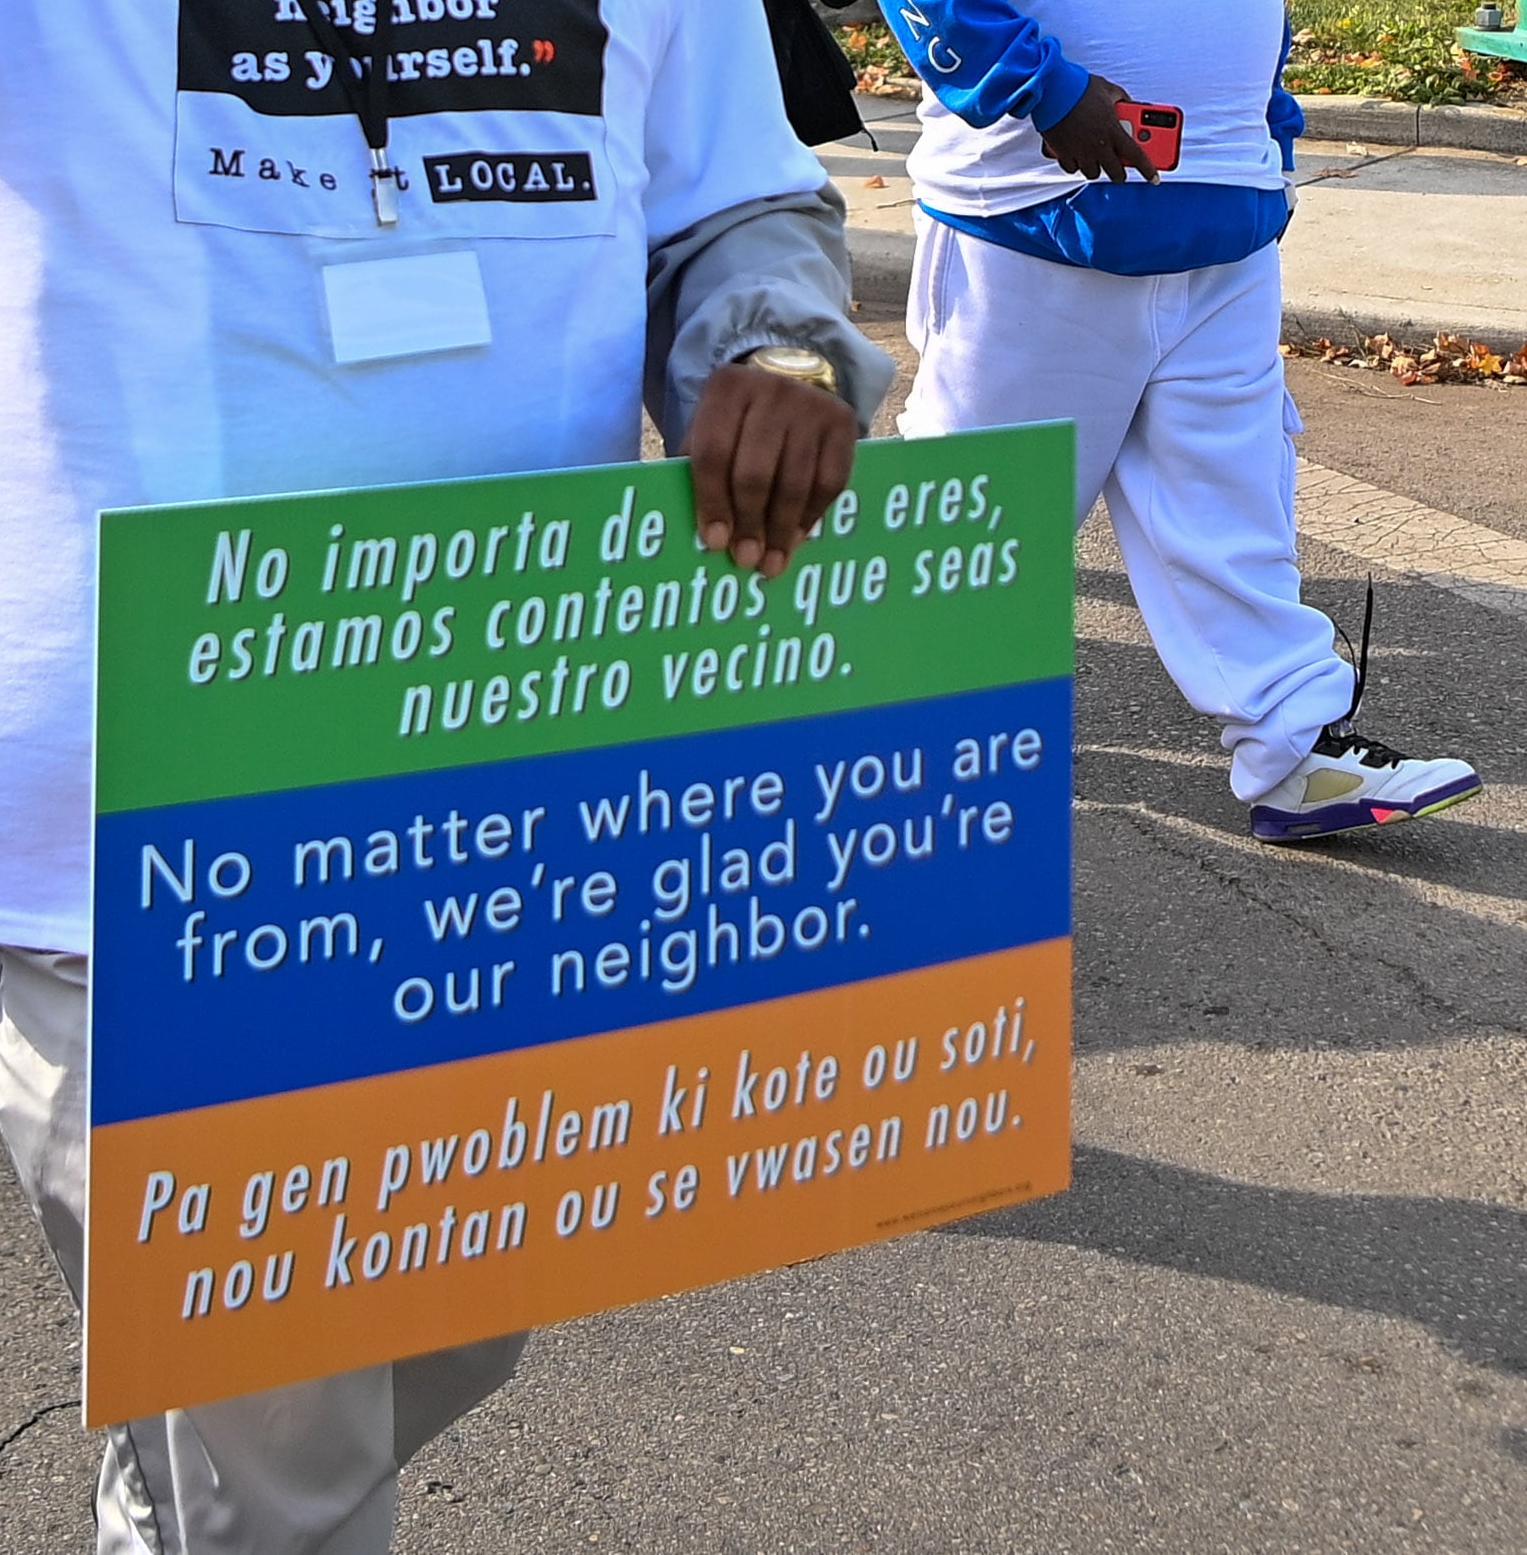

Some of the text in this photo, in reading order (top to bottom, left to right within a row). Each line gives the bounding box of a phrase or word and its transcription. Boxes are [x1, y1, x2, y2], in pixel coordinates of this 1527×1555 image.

[231, 51, 291, 82] as
[209, 147, 592, 193] Make t LOCAL.
[206, 529, 288, 604] No
[321, 511, 570, 602] importa
[600, 485, 664, 562] de
[884, 474, 1002, 529] eres,
[188, 538, 1019, 683] estamos contentos que seas
[399, 632, 852, 735] nuestro vecino.
[142, 729, 1041, 908] No matter where you are
[177, 794, 1012, 980] from, we’re glad you’re
[394, 896, 868, 1020] our neighbor.
[136, 1006, 1035, 1243] Pa gen pwoblem ki kote ou soti,
[180, 1089, 1021, 1320] nou kontan ou se vwasen nou.
